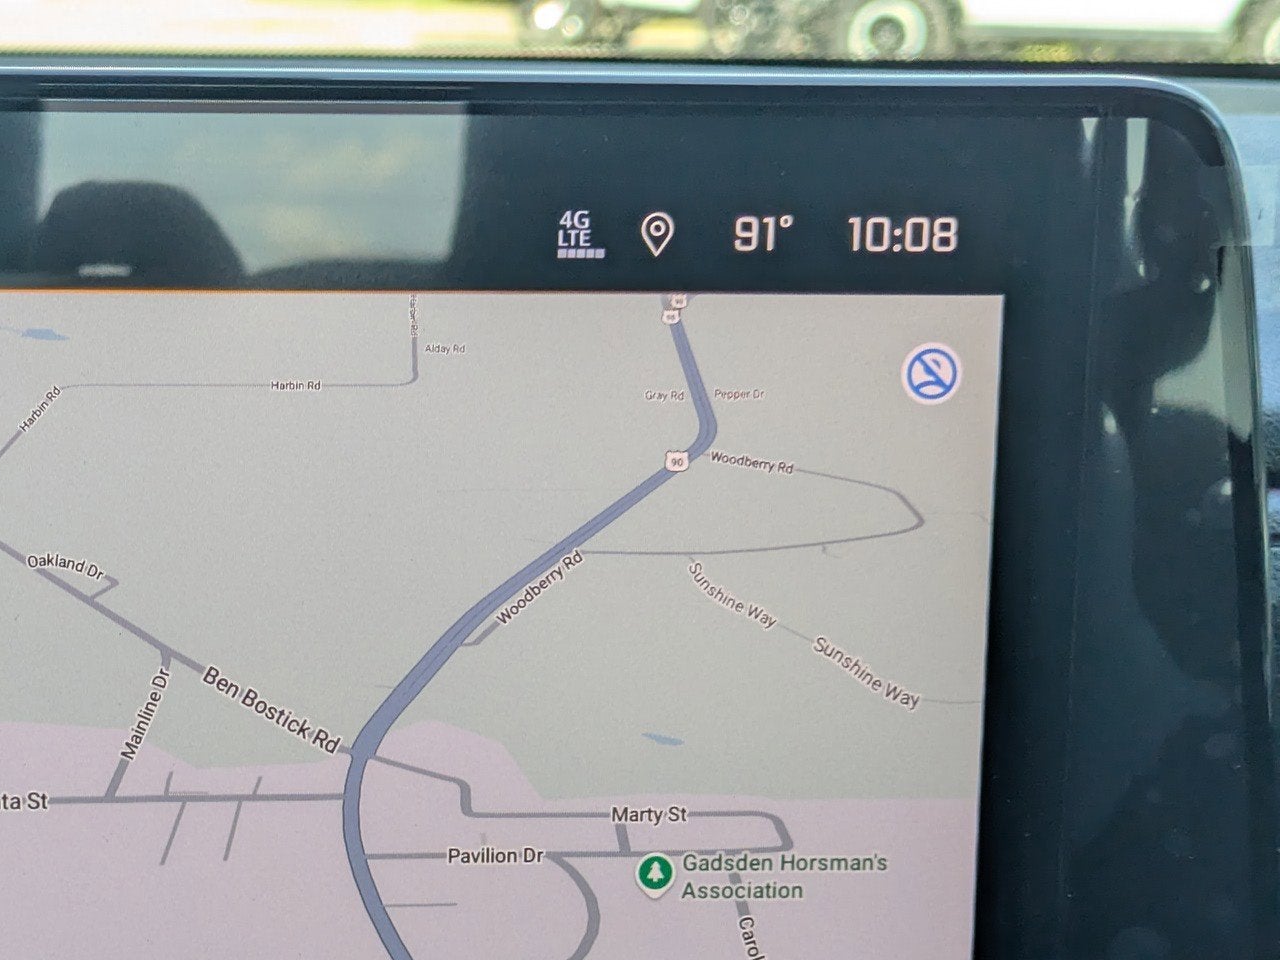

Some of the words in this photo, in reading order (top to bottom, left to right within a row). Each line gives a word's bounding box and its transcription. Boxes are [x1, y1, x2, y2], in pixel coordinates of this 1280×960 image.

[558, 209, 591, 229] 4G
[557, 230, 592, 248] LTE
[733, 213, 795, 253] 91°
[847, 215, 960, 254] 10:08
[425, 344, 451, 355] Alday
[453, 344, 466, 353] Rd
[270, 380, 304, 391] Harbin
[306, 380, 322, 391] Rd
[645, 390, 668, 403] Gray
[670, 389, 685, 401] Rd
[714, 389, 749, 402] Pepper
[751, 388, 765, 400] Dr
[17, 400, 48, 433] Harbin
[44, 385, 62, 405] Rd
[670, 457, 684, 468] 90
[710, 450, 776, 474] Woodberry
[777, 461, 795, 476] Rd
[26, 553, 85, 574] Oakland
[86, 563, 105, 582] Dr
[495, 565, 565, 627] Woodberry
[561, 550, 584, 572] Rd
[687, 562, 744, 615] Sunshine
[741, 603, 778, 630] Way
[812, 636, 882, 692] Sunshine
[881, 679, 920, 712] Way
[120, 690, 163, 762] Mainline
[151, 667, 170, 691] Dr
[201, 665, 240, 700] Ben
[240, 688, 313, 741] Bostick
[310, 727, 342, 755] Rd
[26, 791, 49, 811] St
[611, 806, 665, 828] Marty
[668, 806, 687, 823] St
[447, 847, 518, 864] Pavilion
[523, 848, 544, 864] Dr
[681, 854, 773, 873] Gadsden
[780, 853, 888, 873] Horsman's
[681, 881, 804, 900] Association
